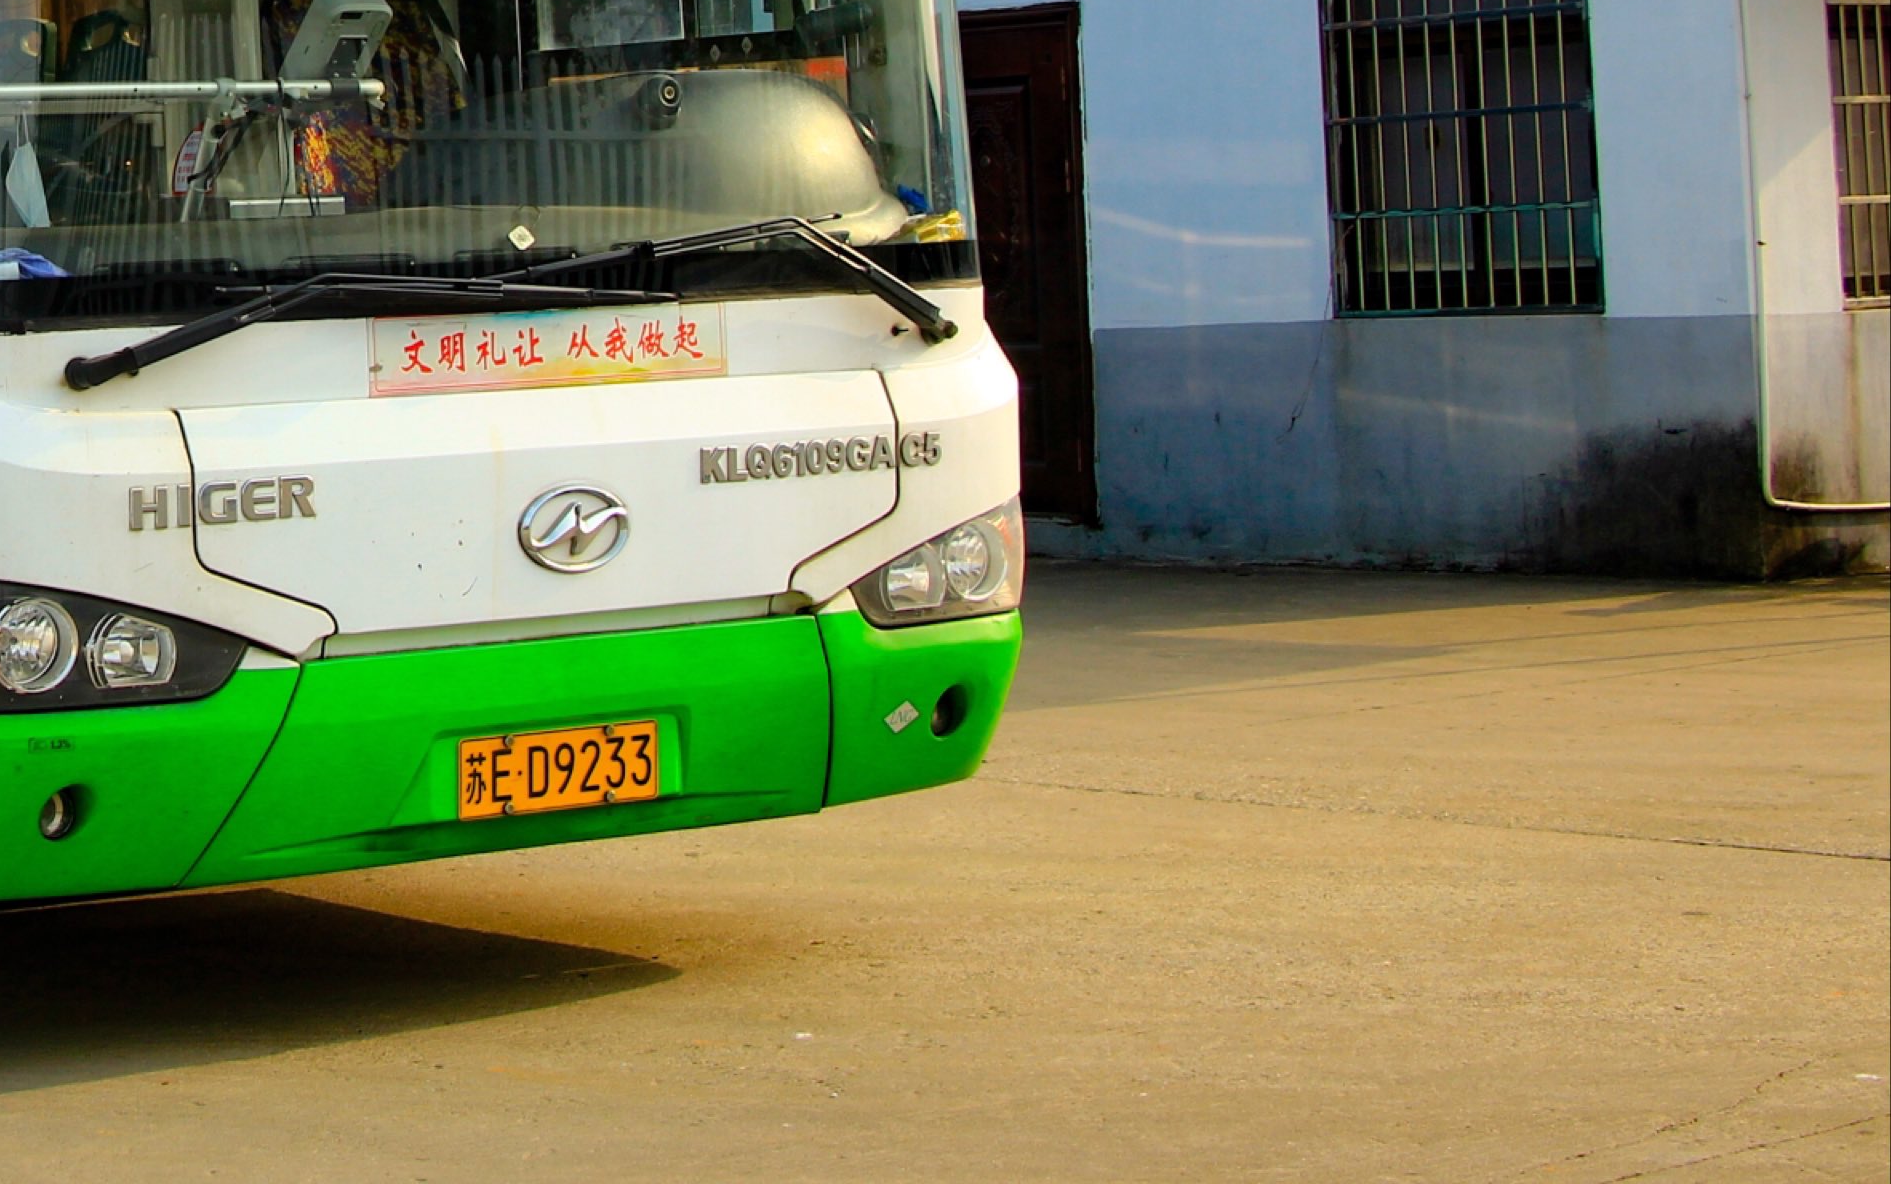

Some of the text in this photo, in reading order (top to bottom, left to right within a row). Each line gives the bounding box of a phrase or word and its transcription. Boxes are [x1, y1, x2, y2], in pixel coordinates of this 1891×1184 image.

[402, 317, 704, 373] 文明礼让 从我做起
[128, 474, 317, 531] HIGER
